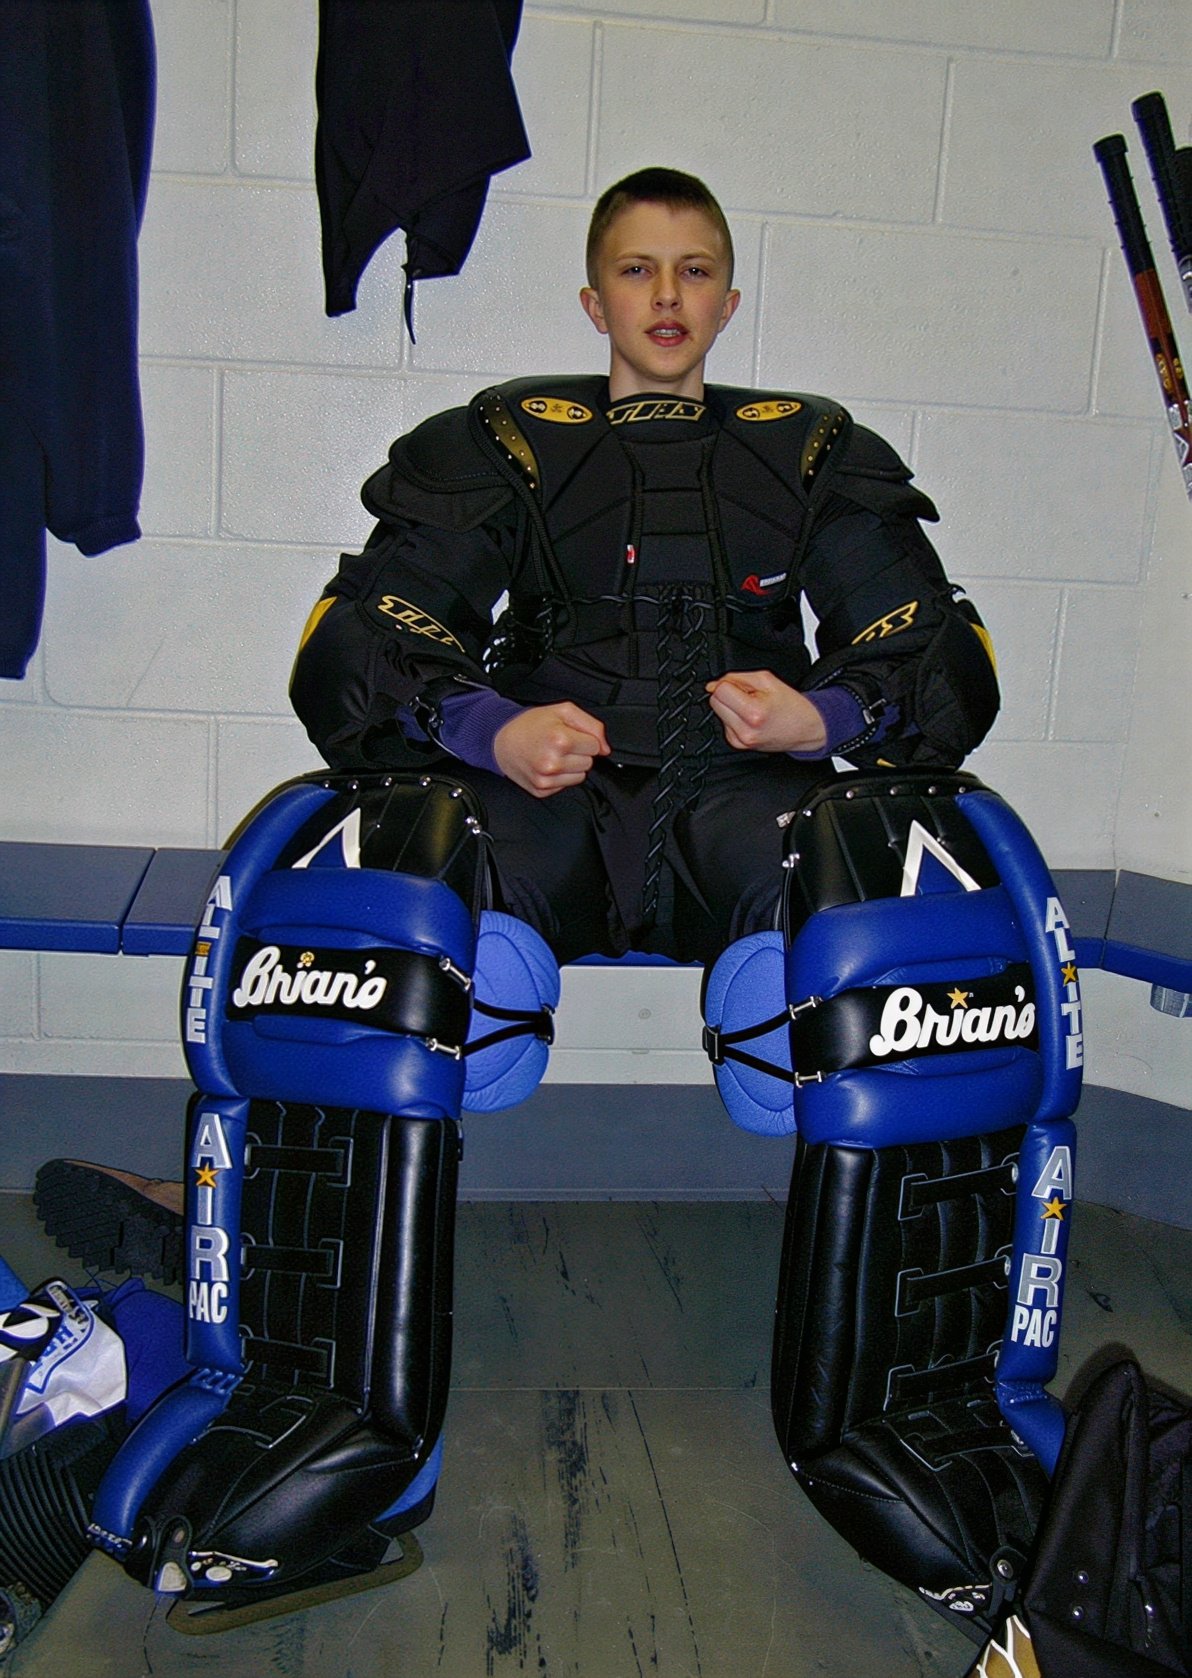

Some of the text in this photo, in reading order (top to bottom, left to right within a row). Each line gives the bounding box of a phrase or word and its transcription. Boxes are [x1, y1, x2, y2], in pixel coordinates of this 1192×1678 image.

[233, 946, 387, 1010] Brian's
[869, 985, 1035, 1057] Brian's
[1016, 1145, 1072, 1308] AIR
[189, 1281, 229, 1325] PAC
[1011, 1304, 1058, 1348] PAC
